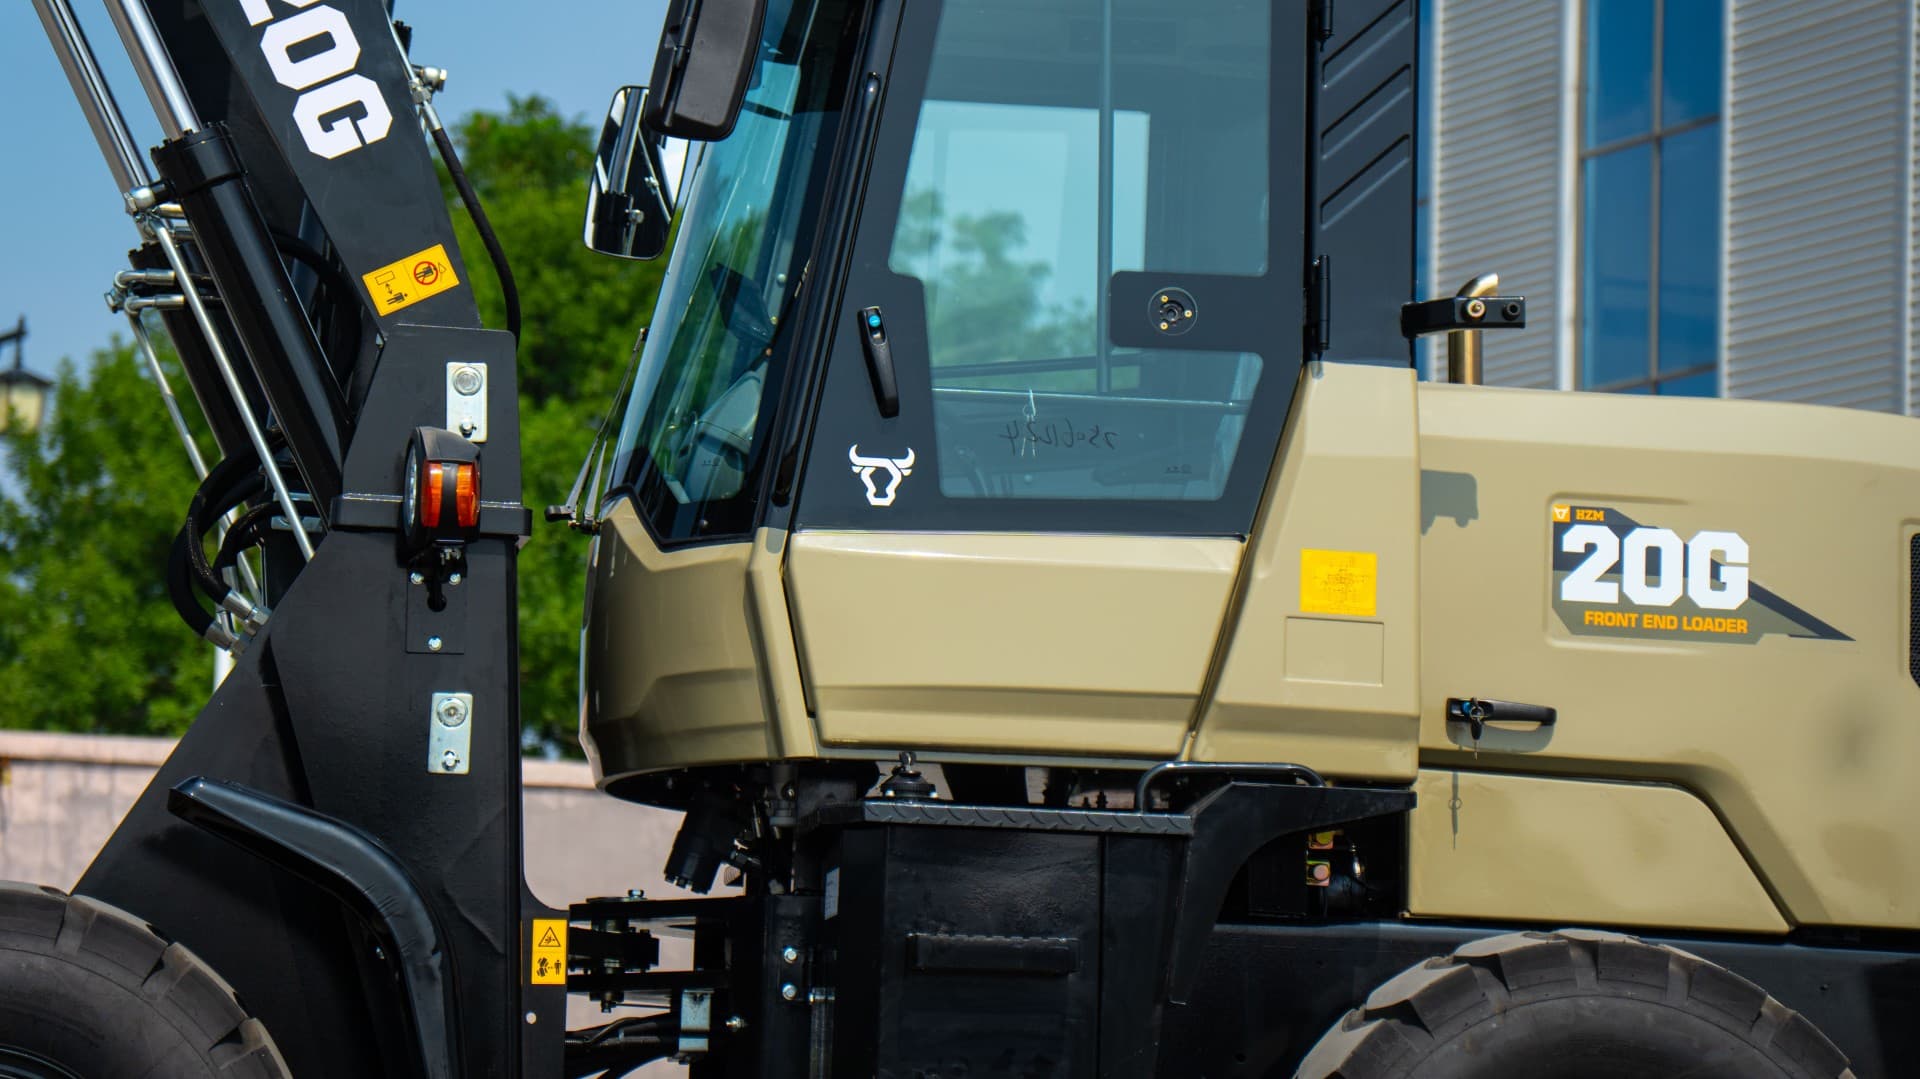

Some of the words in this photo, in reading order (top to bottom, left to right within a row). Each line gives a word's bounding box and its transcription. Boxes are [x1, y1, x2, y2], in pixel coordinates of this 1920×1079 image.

[1576, 509, 1604, 522] HZM
[1561, 523, 1749, 610] 20G
[1584, 610, 1639, 628] FRONT
[1642, 614, 1678, 630] END
[1682, 615, 1748, 634] LOADER
